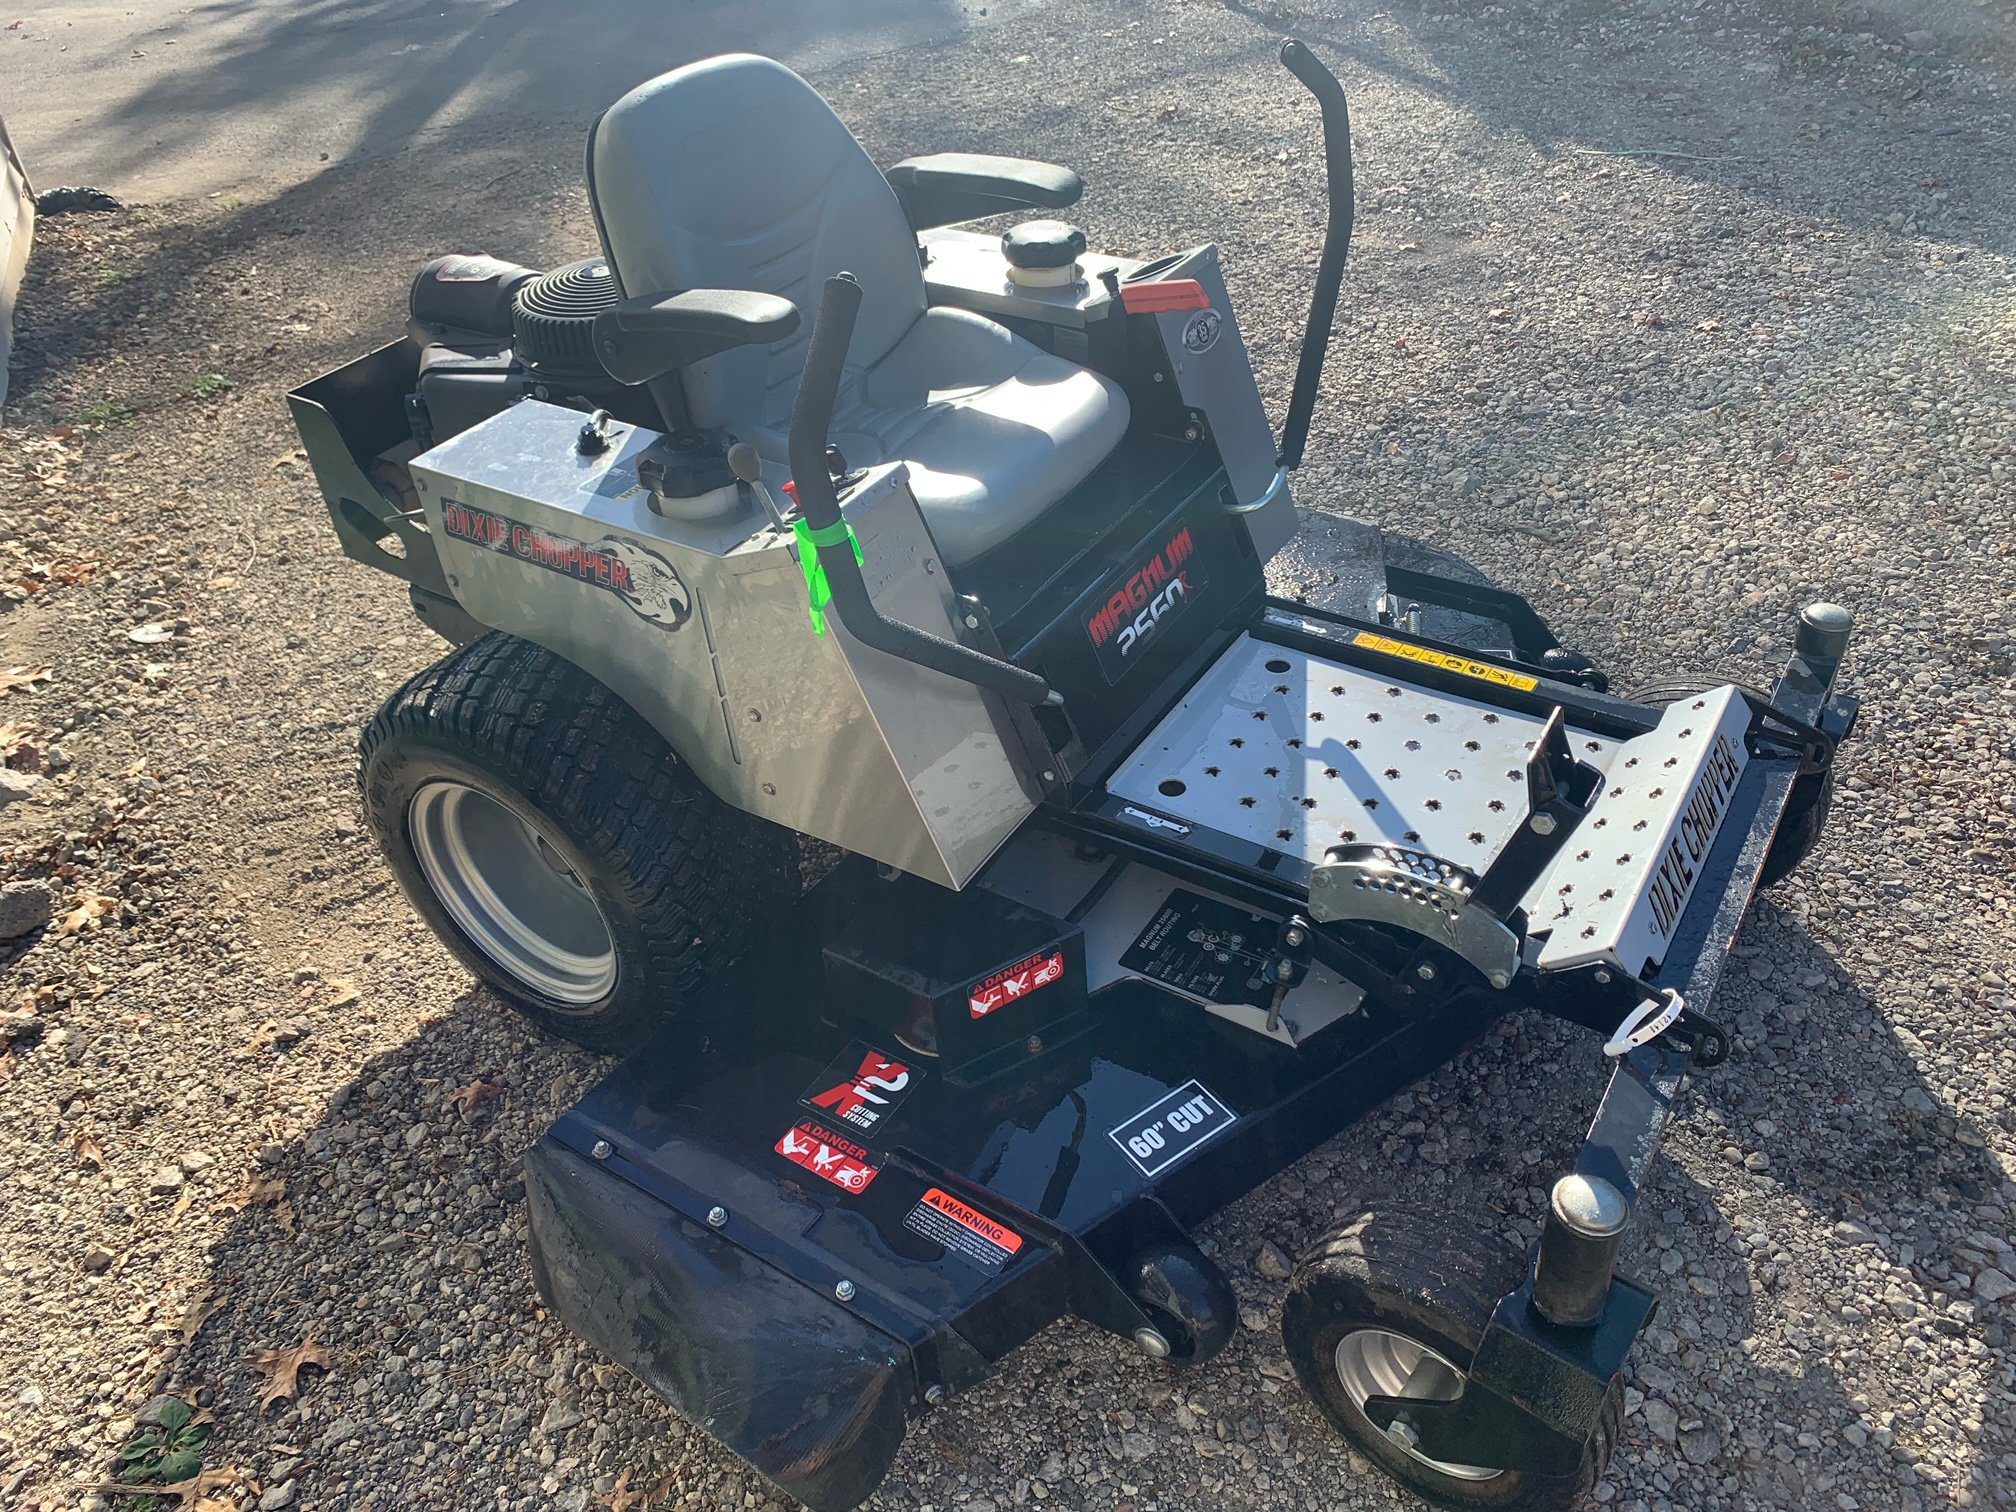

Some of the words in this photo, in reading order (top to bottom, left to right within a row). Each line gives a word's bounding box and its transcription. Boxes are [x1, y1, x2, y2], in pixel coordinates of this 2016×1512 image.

[512, 525, 630, 591] CHOPPER
[1088, 527, 1193, 648] MAGNUM
[1648, 834, 1693, 940] DIXIE
[1681, 734, 1739, 863] CHOPPER
[1139, 923, 1161, 949] MAGNUM
[1148, 936, 1163, 951] BELT
[1159, 912, 1181, 937] ROUTING
[985, 954, 1042, 989] DANGER
[842, 1110, 872, 1128] SYSTEM
[850, 1104, 879, 1121] CUTTING
[1167, 1094, 1214, 1132] CUT
[811, 1126, 867, 1160] DANGER
[943, 1200, 1003, 1240] WARNING
